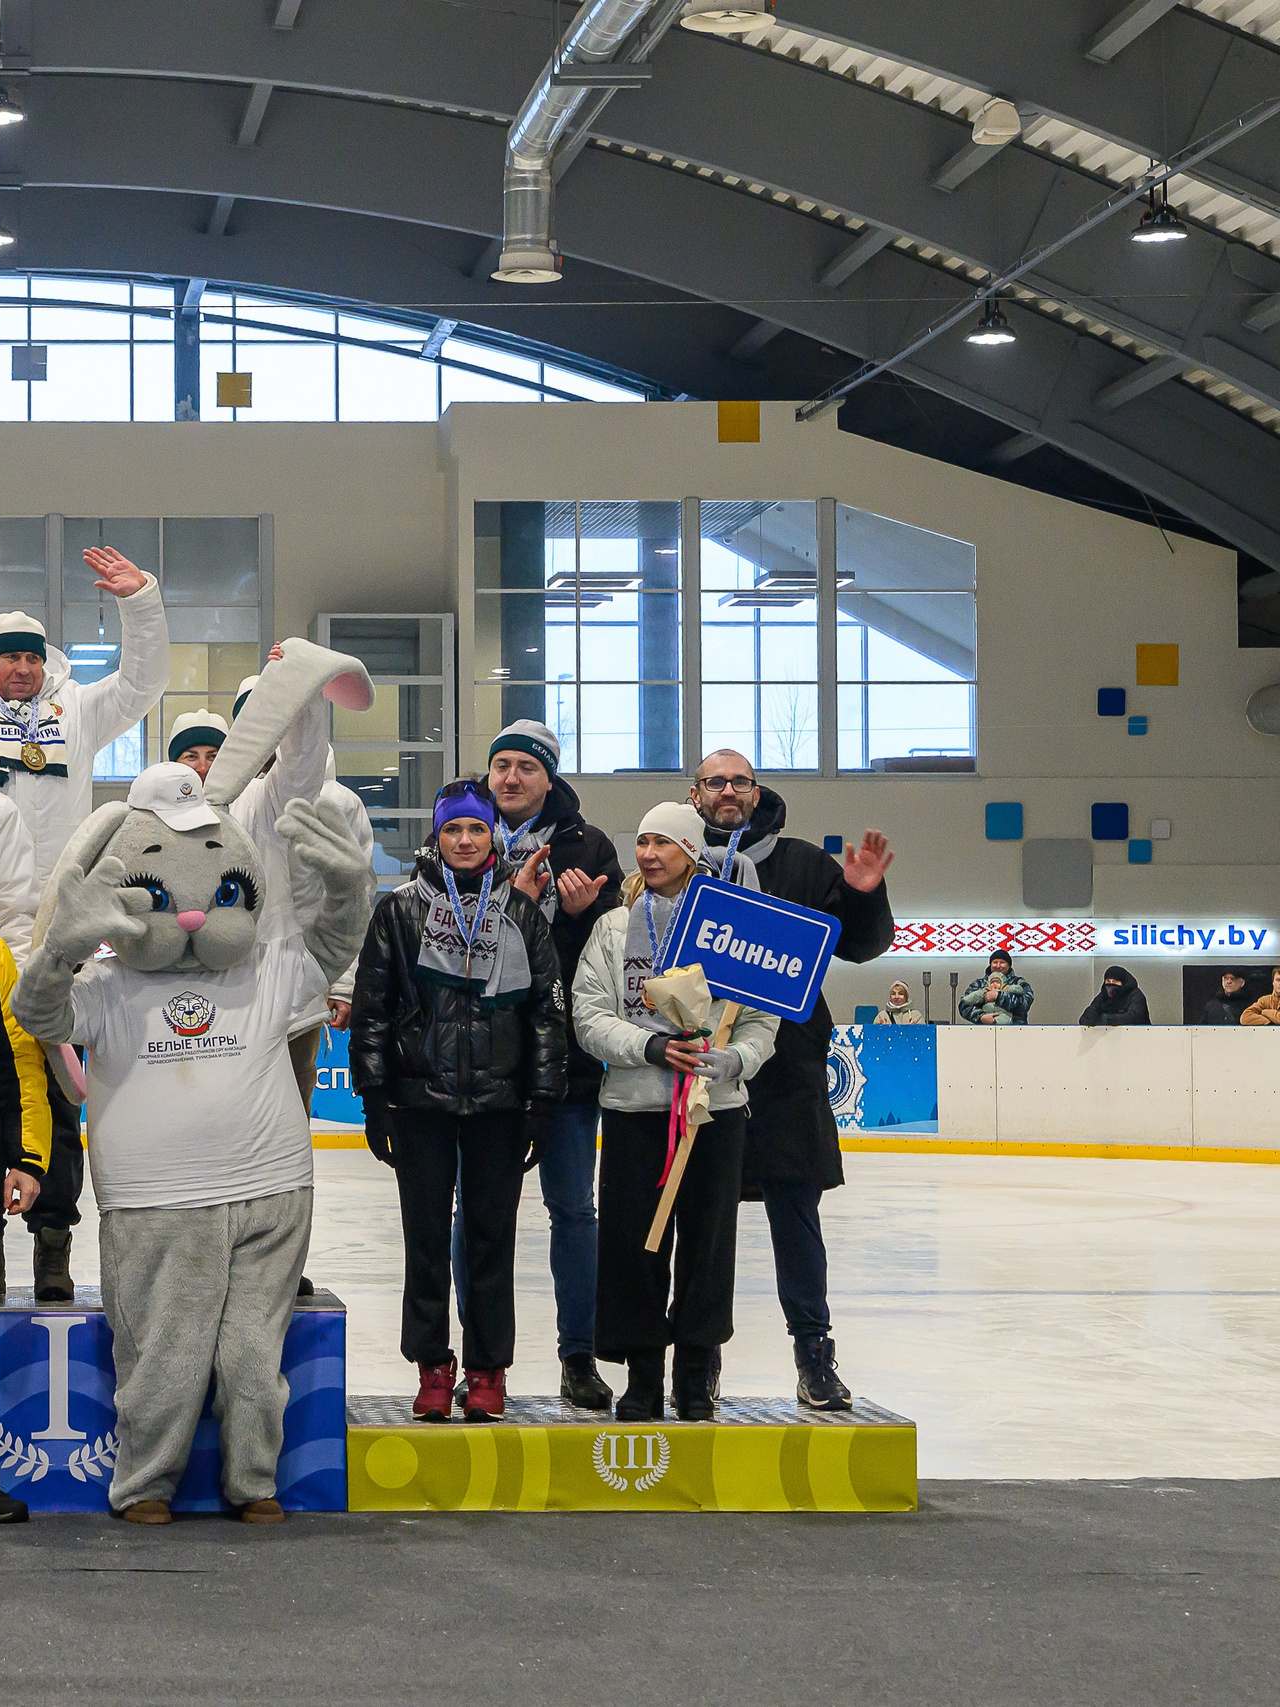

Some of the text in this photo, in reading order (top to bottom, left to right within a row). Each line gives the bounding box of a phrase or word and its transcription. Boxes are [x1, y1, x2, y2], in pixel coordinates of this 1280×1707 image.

[695, 918, 803, 978] Единые
[1114, 924, 1268, 950] silichy.by
[148, 1034, 238, 1053] БЕЛЫЕ ТИГРЫ
[605, 1435, 658, 1469] III
